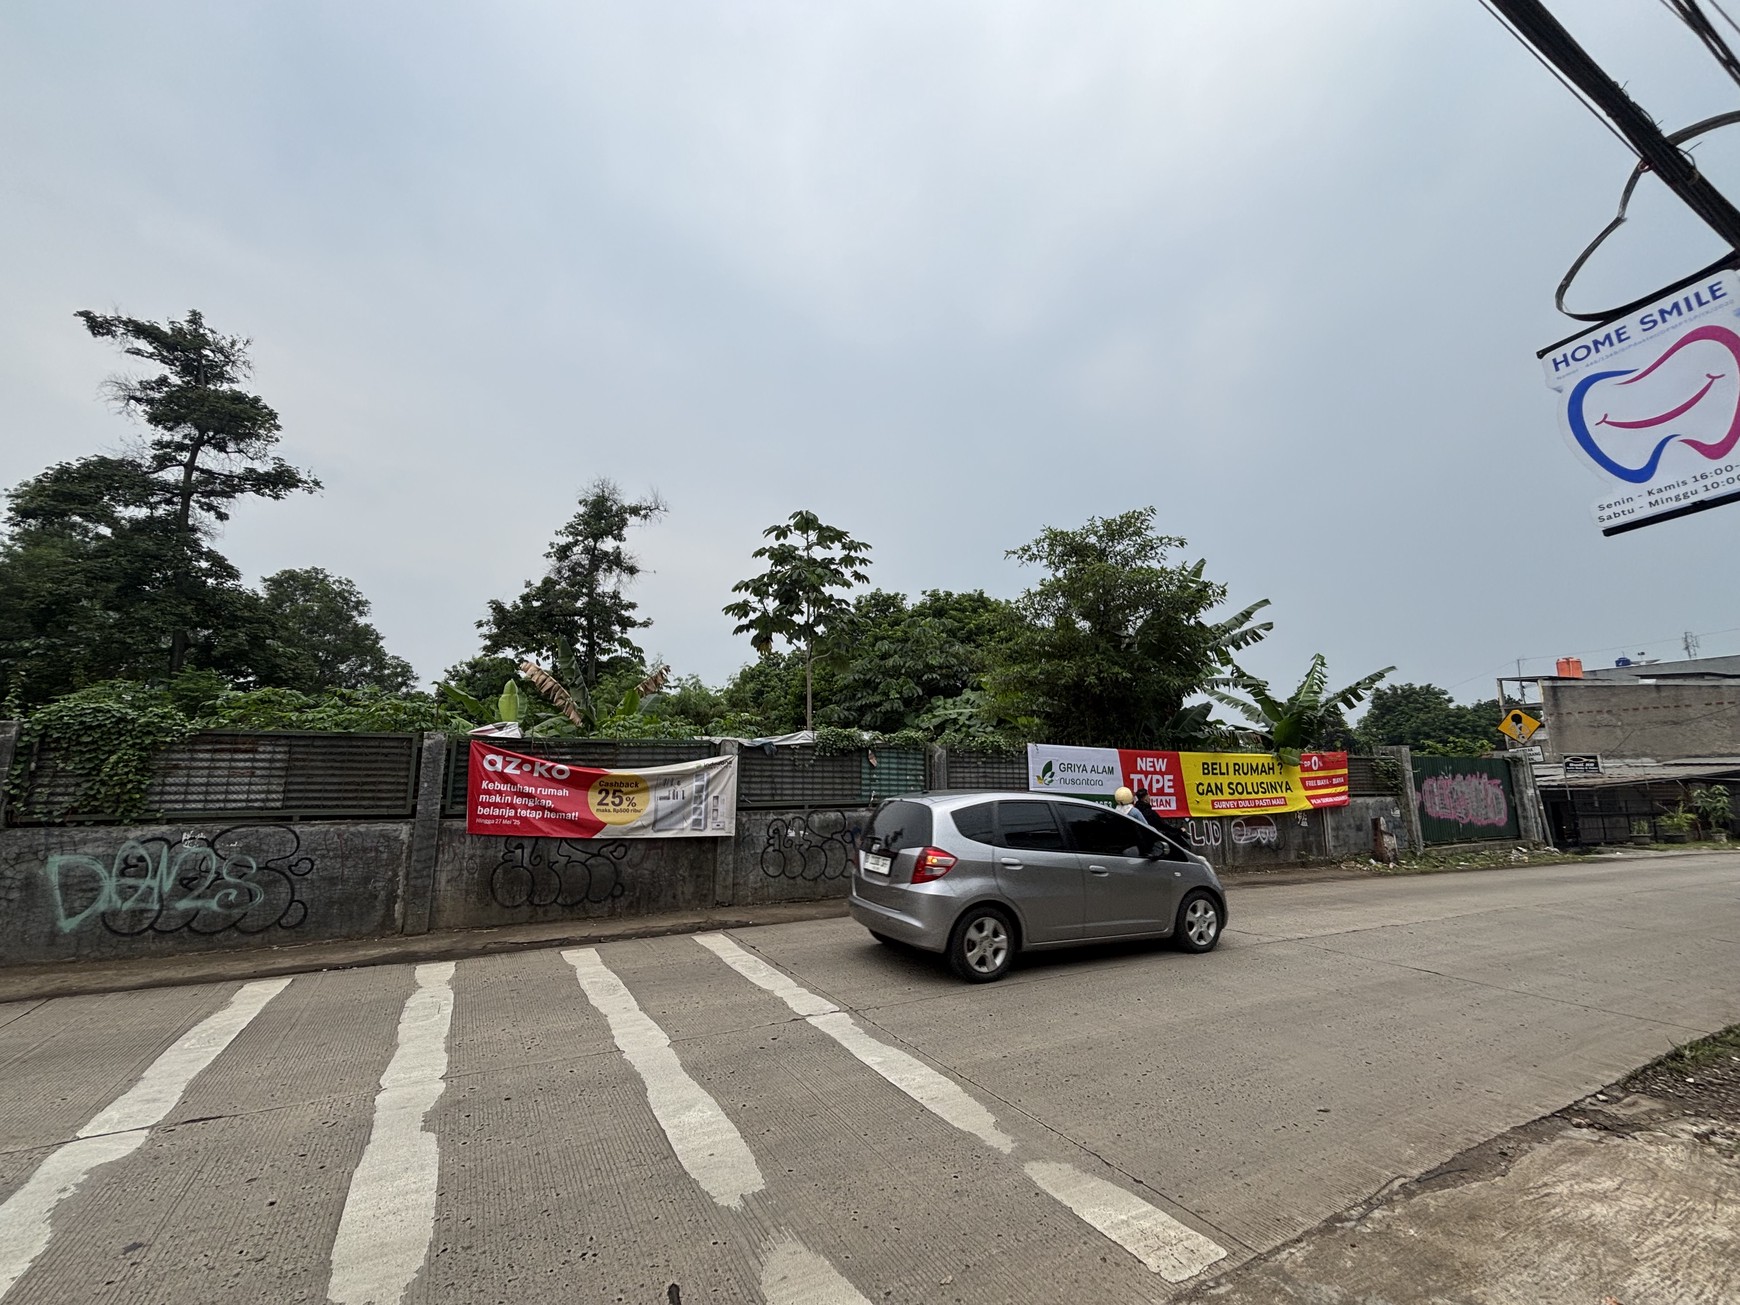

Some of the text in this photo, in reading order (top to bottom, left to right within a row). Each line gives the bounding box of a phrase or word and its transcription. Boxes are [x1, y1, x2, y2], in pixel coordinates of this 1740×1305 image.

[1552, 325, 1631, 372] HOME
[1639, 280, 1728, 332] SMILE
[1598, 496, 1634, 512] Senin
[1647, 480, 1688, 497] Kamis
[1598, 508, 1635, 523] Sabtu
[1649, 488, 1698, 508] Minggu
[1058, 762, 1115, 775] GRIYA ALAM
[1137, 757, 1168, 772] NEW
[1202, 761, 1284, 776] BELI RUMAH ?
[481, 780, 569, 796] Kebutuhan rumah
[598, 780, 640, 789] Cashback
[1059, 777, 1104, 787] nusantara
[1130, 774, 1175, 793] TYPE
[1196, 781, 1294, 796] GAN SOLUSINYA
[479, 794, 555, 808] makin lengkap,
[596, 788, 637, 808] 25 %
[1213, 800, 1238, 809] SURVEY
[1238, 799, 1255, 808] DULU
[1255, 798, 1272, 807] PASTI
[477, 806, 579, 821] belanja tetap hemat!
